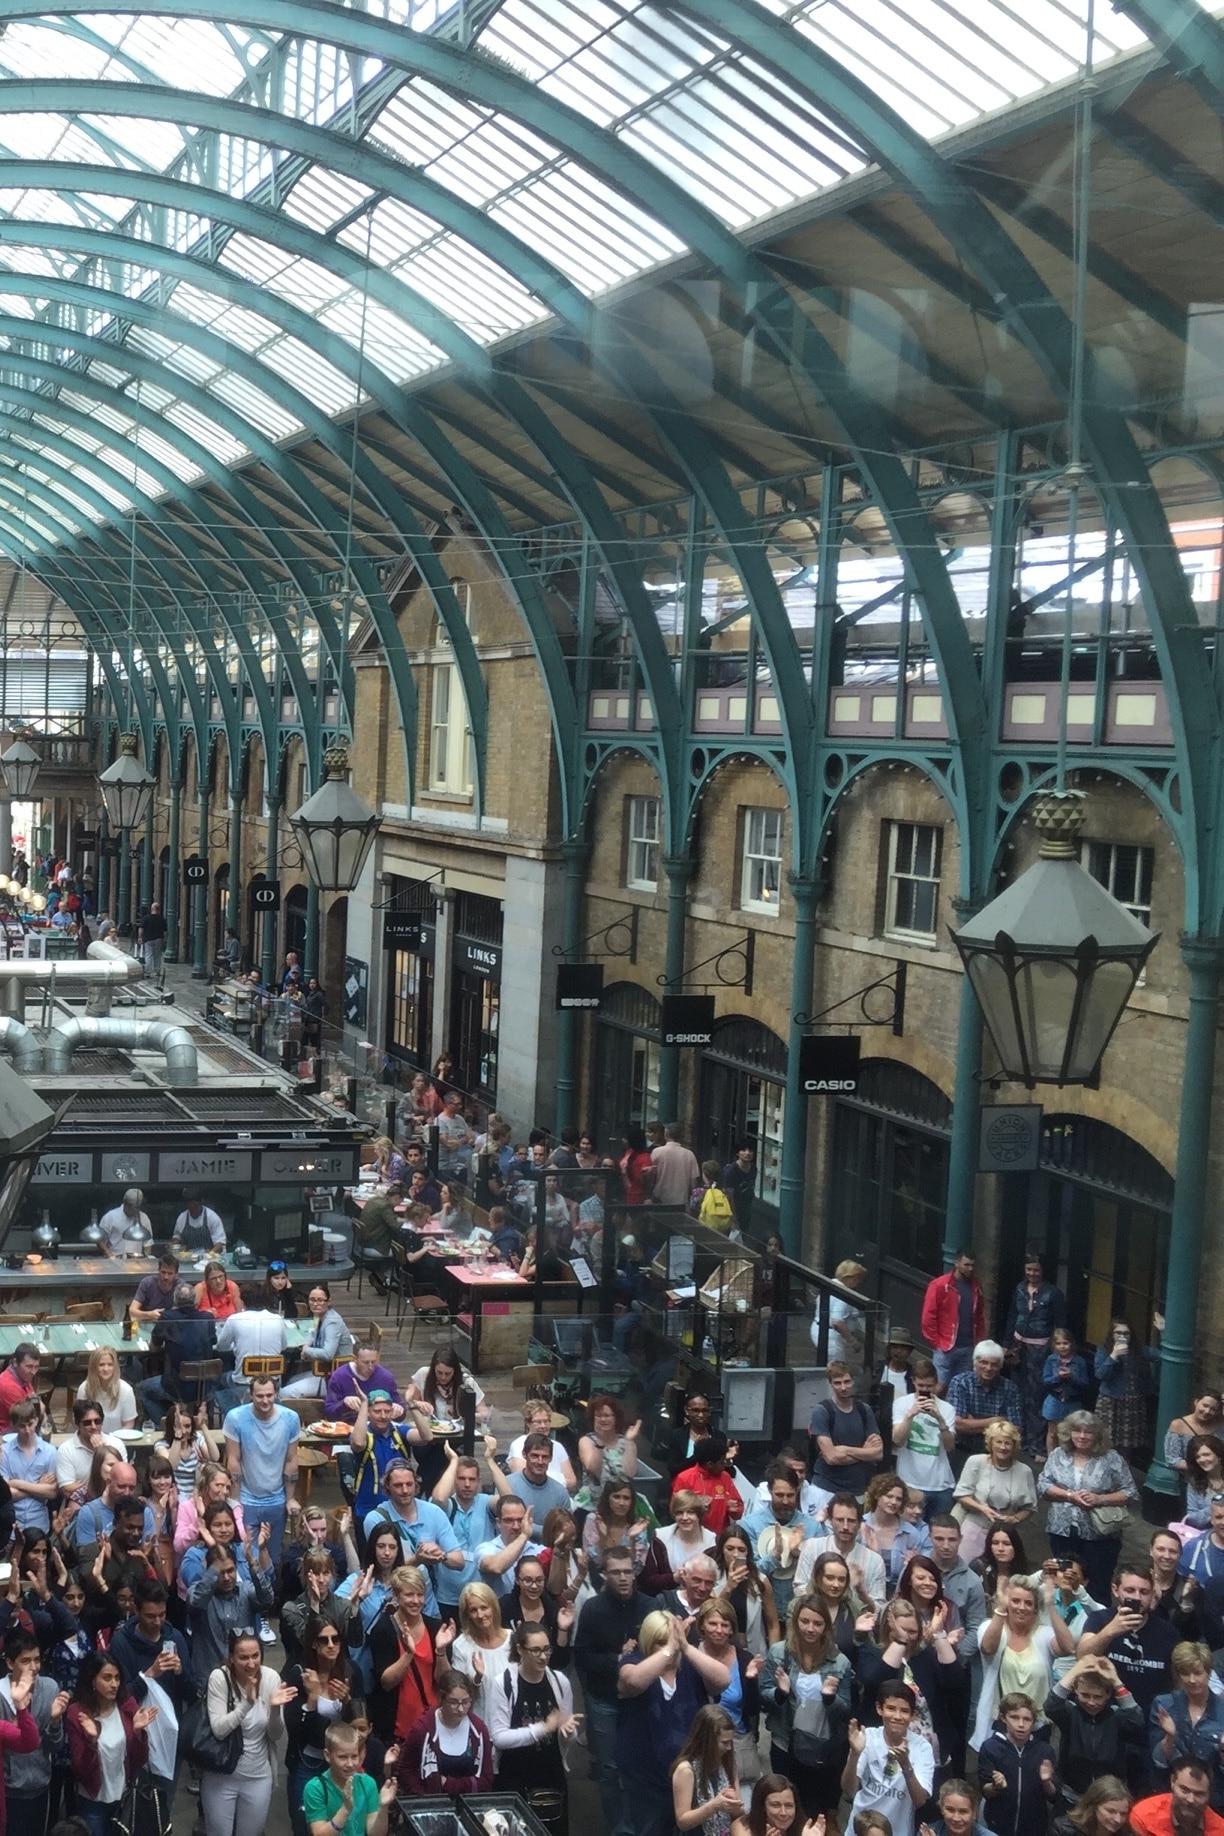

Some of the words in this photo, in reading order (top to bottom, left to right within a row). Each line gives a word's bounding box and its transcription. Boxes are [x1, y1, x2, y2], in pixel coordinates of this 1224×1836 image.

[385, 925, 420, 933] LINKS
[467, 946, 497, 965] LINKS
[665, 1033, 712, 1043] G-SHOCK
[804, 1079, 857, 1091] CASIO
[33, 1161, 80, 1176] IVER
[175, 1159, 236, 1175] JAMIE
